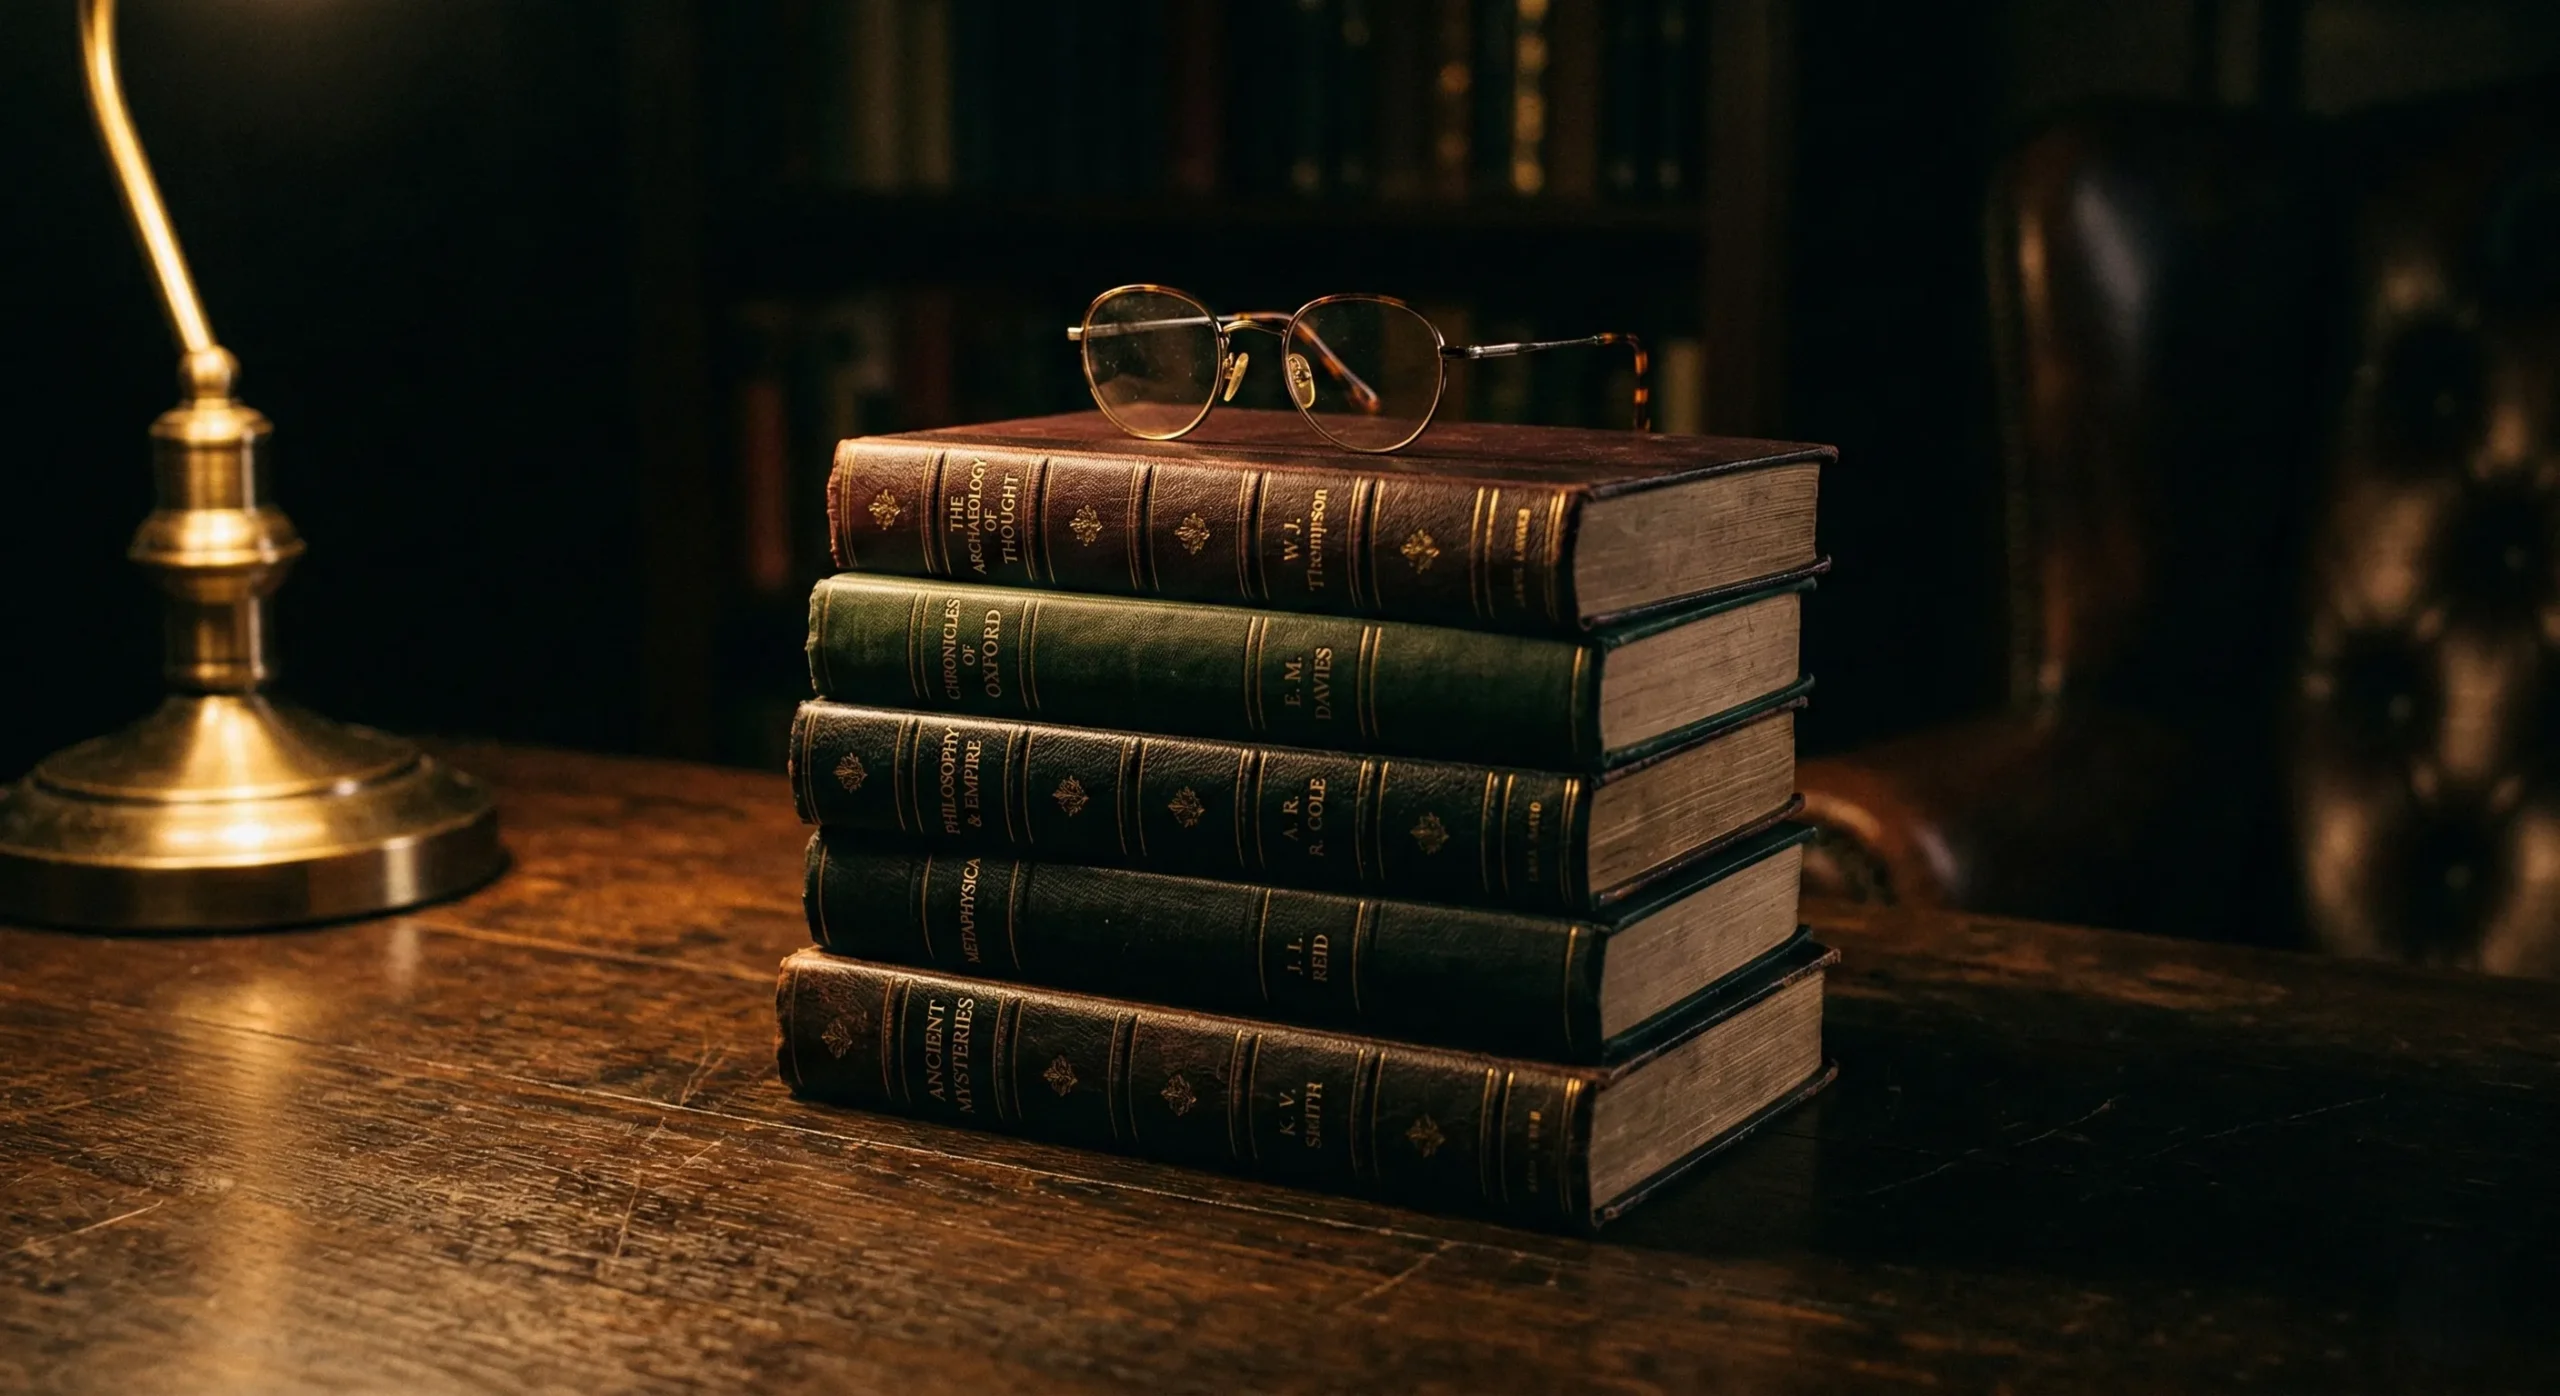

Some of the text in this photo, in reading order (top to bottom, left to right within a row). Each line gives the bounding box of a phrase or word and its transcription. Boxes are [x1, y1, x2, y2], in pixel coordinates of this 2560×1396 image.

[950, 496, 964, 532] THE
[967, 457, 988, 575] ARCHAEOLOGY
[984, 508, 998, 532] OF
[1000, 473, 1019, 565] THOUGHT
[942, 598, 961, 700] CHRONICLES
[962, 644, 976, 666] OF
[982, 609, 1002, 698] OXFORD
[1284, 656, 1303, 708] E. M.
[1313, 647, 1333, 720] DAVIES
[940, 725, 961, 836] PHILOSOPHY
[964, 740, 982, 828] & EMPIRE
[1282, 795, 1300, 841] A. R.
[1307, 778, 1327, 857] R. COLE
[960, 857, 981, 964] METAPHYSICA
[1312, 933, 1329, 982] REID
[925, 999, 947, 1102] ANCIENT
[952, 997, 976, 1114] MYSTERIES
[1278, 1088, 1297, 1108] V.
